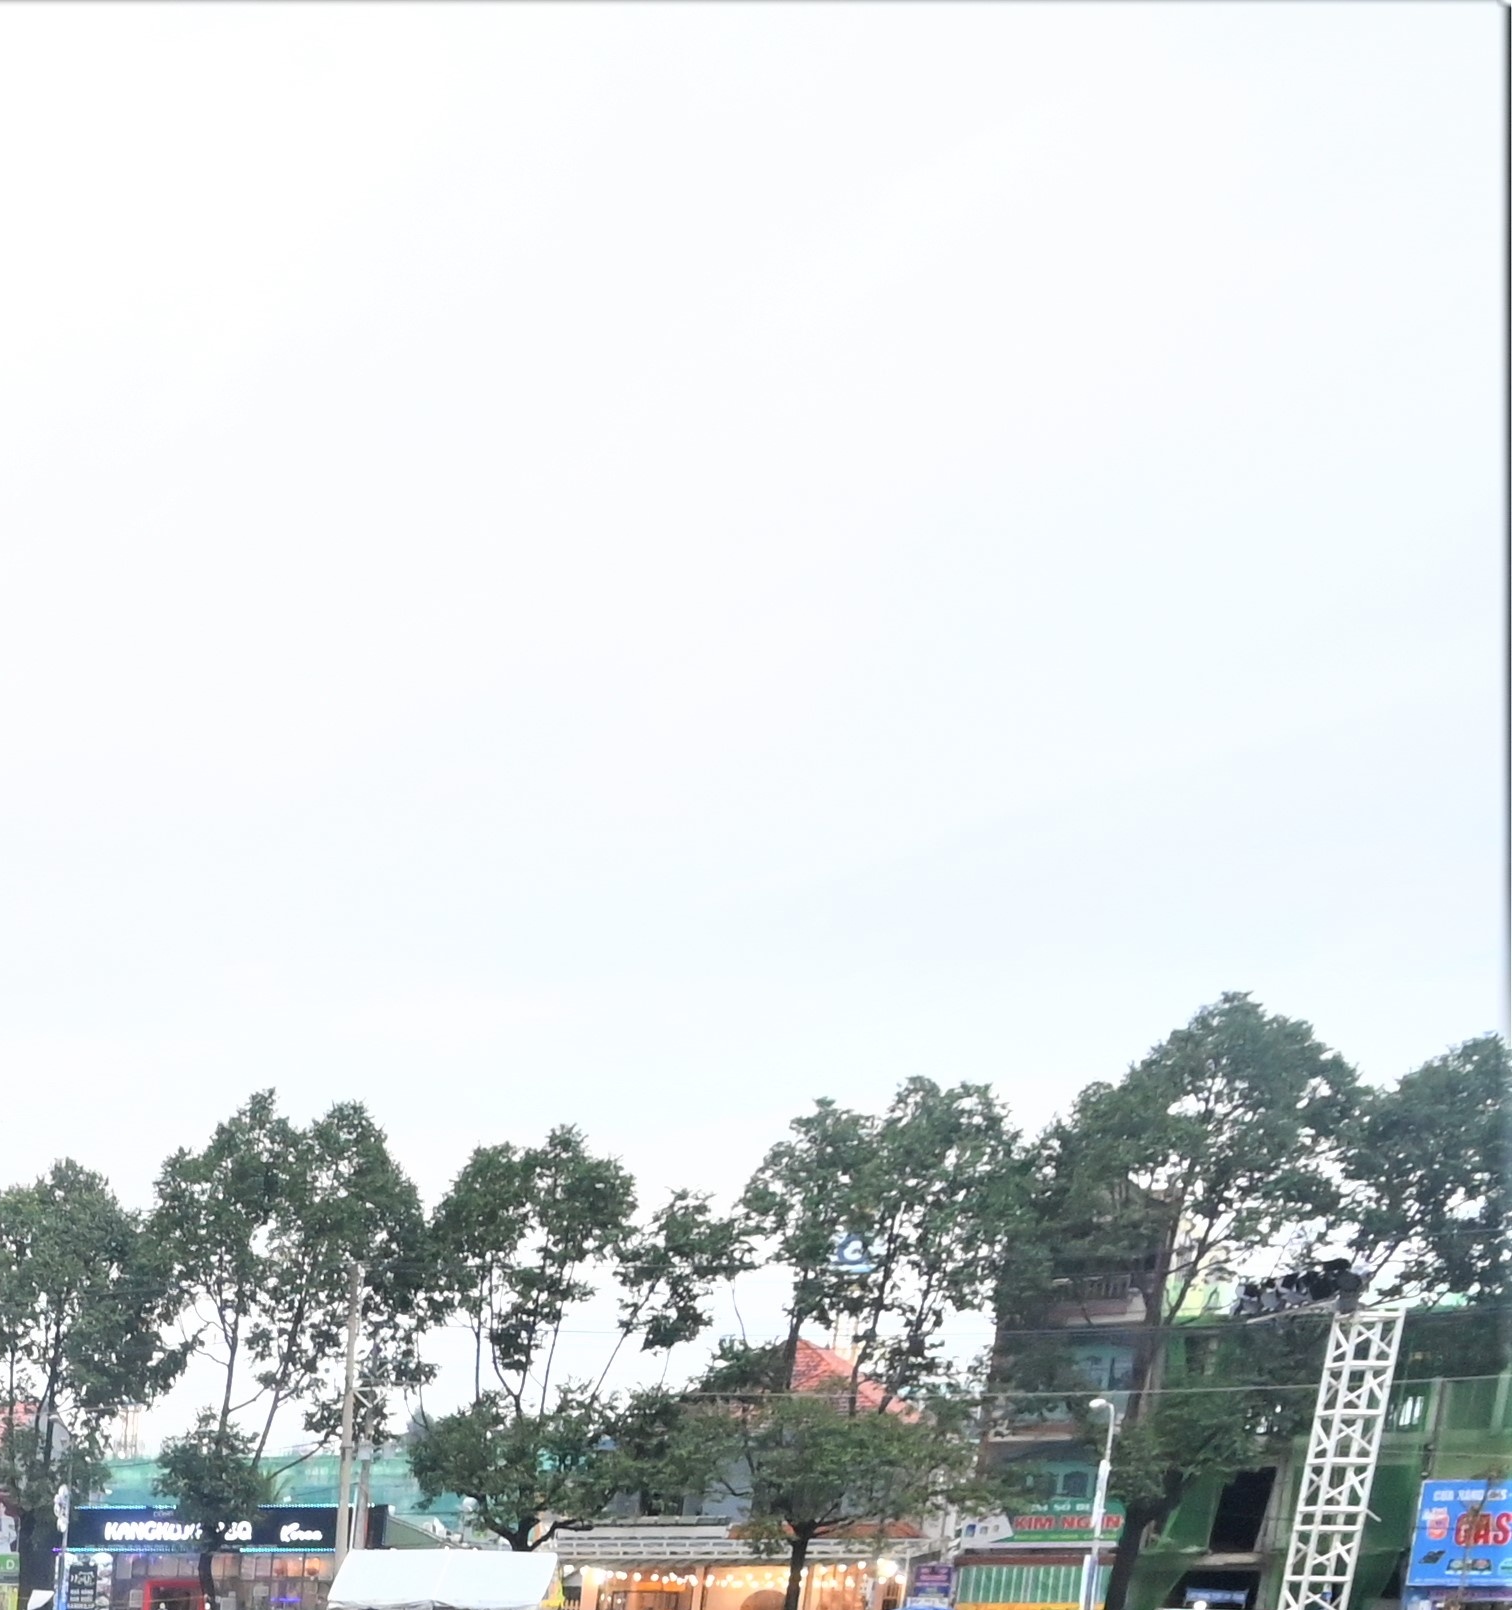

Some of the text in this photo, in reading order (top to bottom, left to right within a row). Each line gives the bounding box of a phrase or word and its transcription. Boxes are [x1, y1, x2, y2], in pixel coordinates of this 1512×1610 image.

[1013, 1514, 1125, 1531] KIM NGN
[1454, 1511, 1512, 1546] GAS
